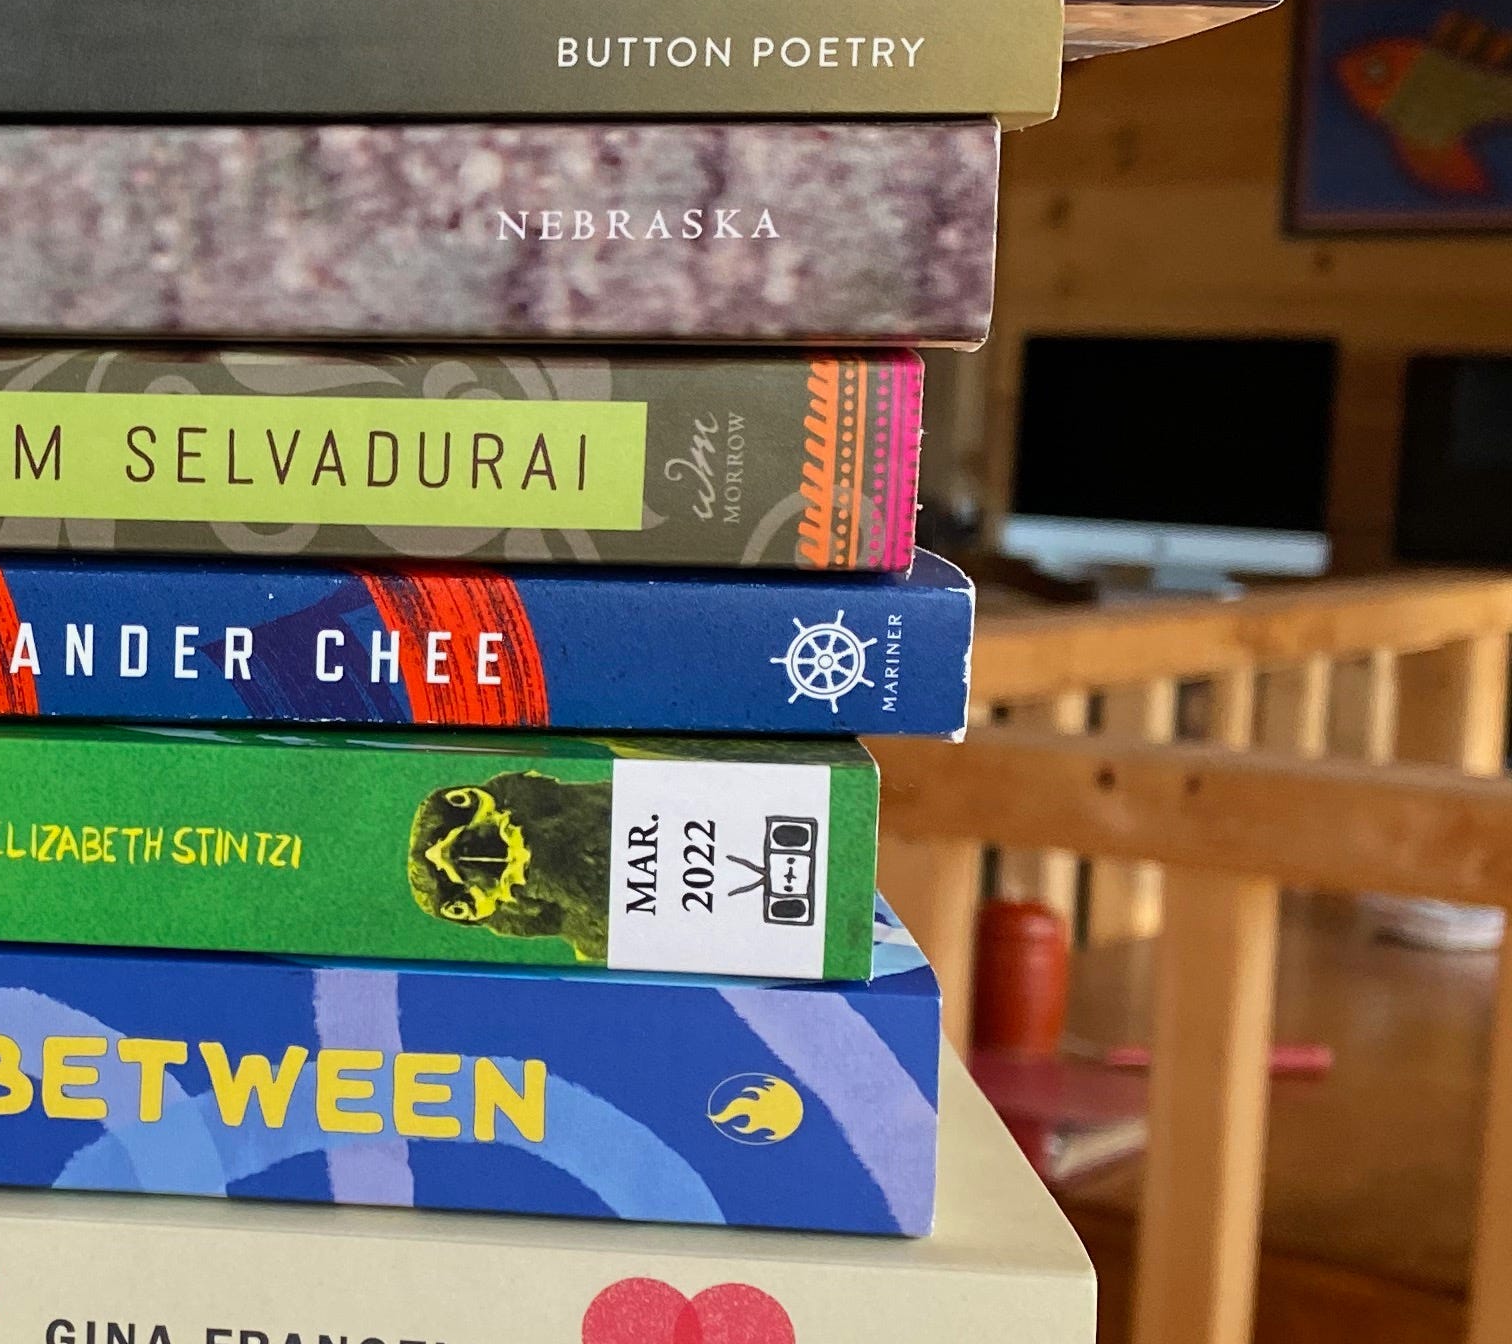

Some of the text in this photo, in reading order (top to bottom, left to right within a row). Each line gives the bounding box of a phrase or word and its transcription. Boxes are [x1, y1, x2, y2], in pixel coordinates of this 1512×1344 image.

[558, 37, 926, 69] BUTTON POETRY
[497, 209, 781, 241] NEBRASKA
[126, 426, 588, 492] SELVADURAI
[723, 412, 746, 524] MORROW
[315, 628, 503, 686] CHEE
[882, 613, 903, 712] MARINER
[172, 828, 303, 869] STINTZI
[626, 814, 660, 916] MAR.
[682, 819, 716, 914] 2022
